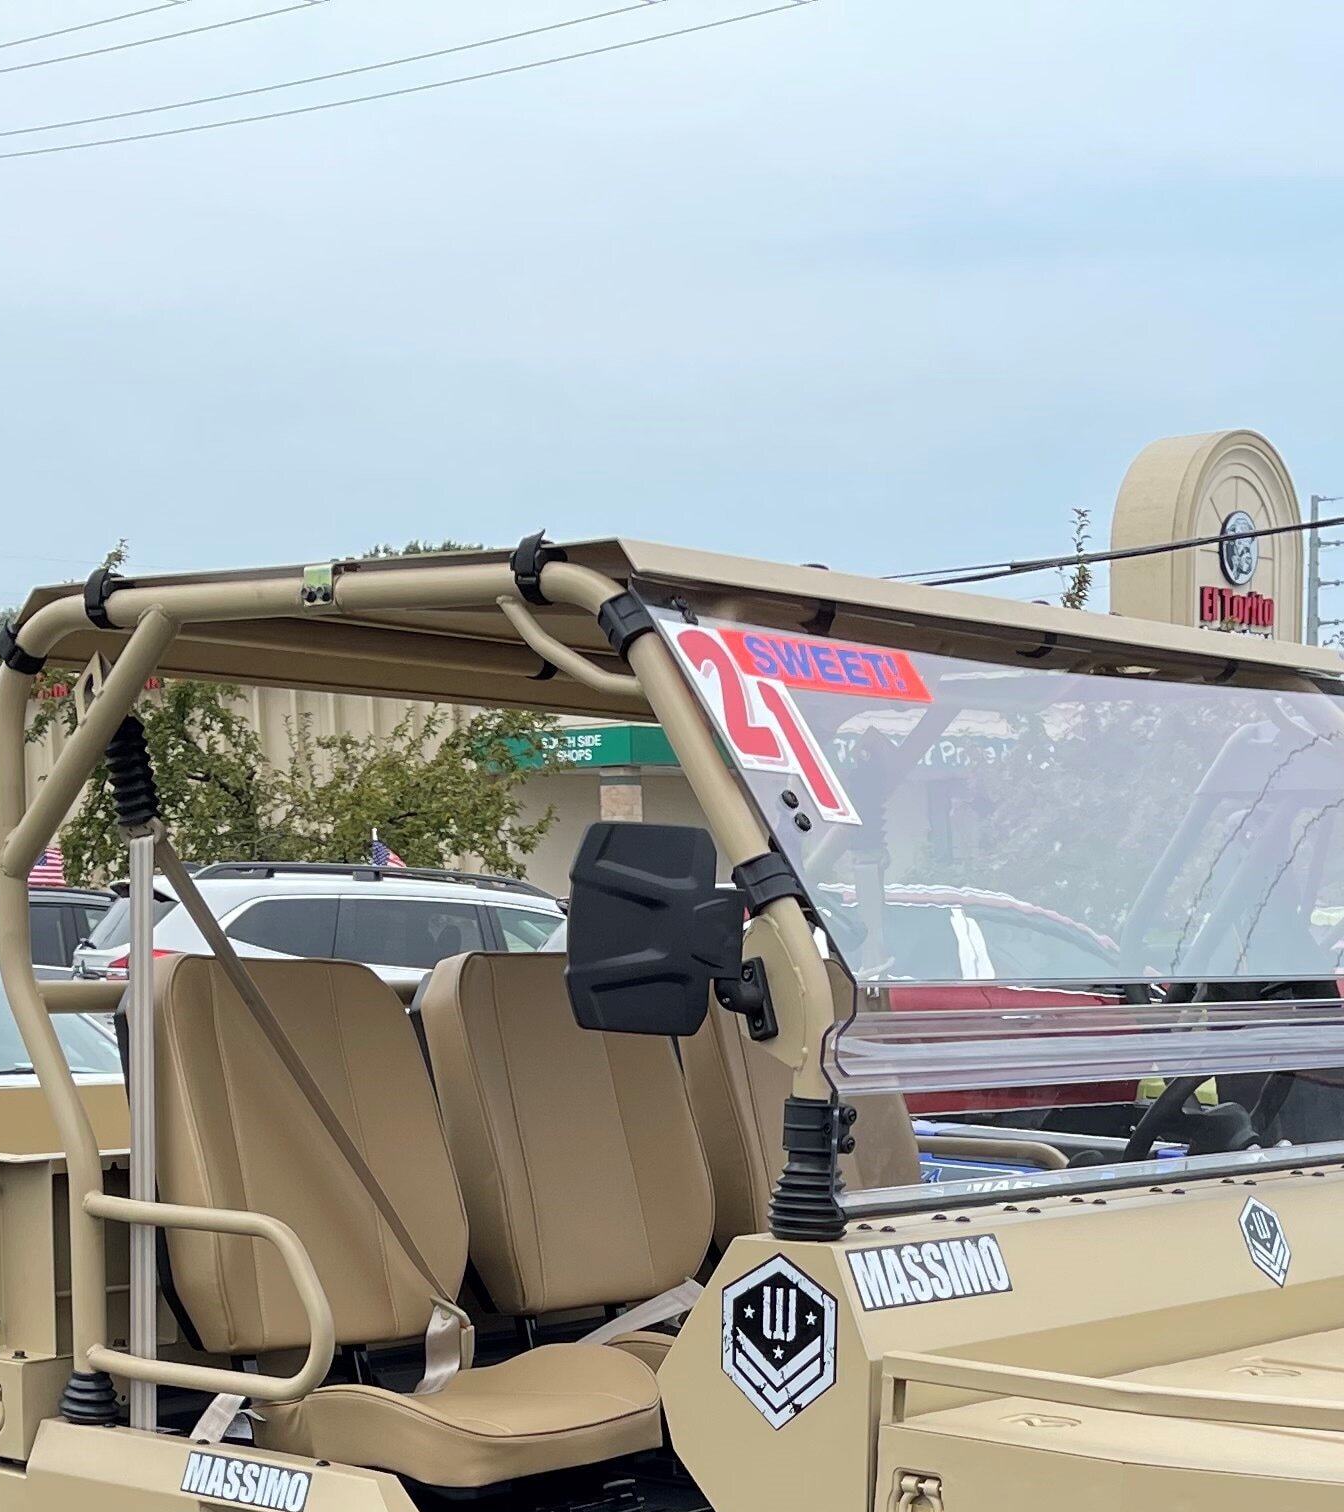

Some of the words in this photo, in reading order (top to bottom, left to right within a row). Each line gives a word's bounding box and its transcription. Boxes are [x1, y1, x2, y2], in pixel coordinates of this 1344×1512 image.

[1200, 586, 1218, 622] El
[1220, 588, 1274, 627] Torito
[744, 635, 906, 691] SWEET!
[577, 735, 602, 747] SIDE
[677, 630, 840, 809] 21
[557, 749, 592, 761] SHOPS
[849, 1236, 1009, 1308] MASSIMO
[182, 1453, 308, 1512] MASSIMO
